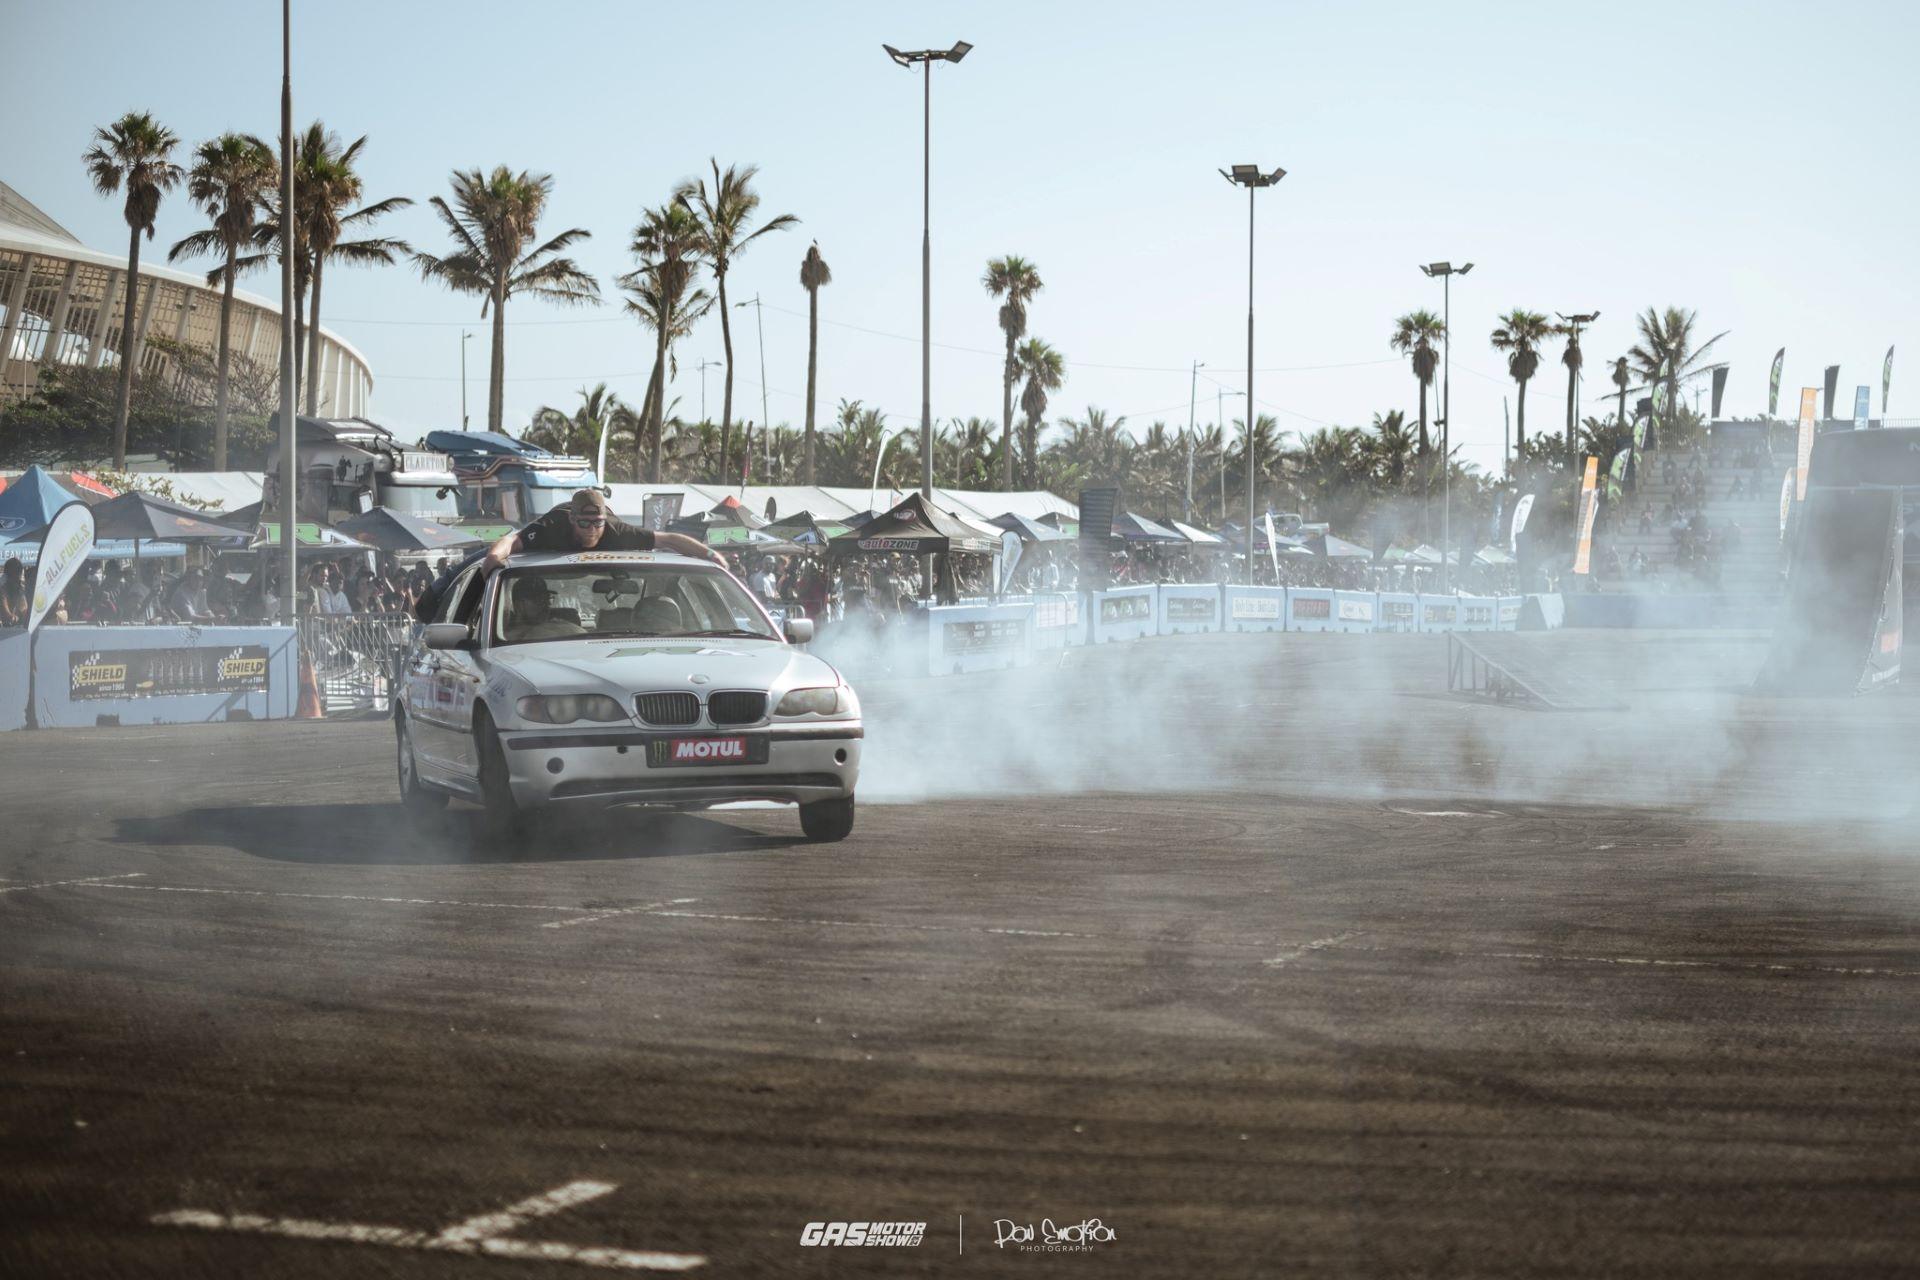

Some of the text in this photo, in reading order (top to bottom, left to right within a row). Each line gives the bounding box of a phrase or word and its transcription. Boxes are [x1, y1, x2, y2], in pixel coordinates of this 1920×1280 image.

[81, 667, 124, 681] SHIELD
[226, 661, 264, 674] SHIELD
[676, 741, 743, 757] MOTUL
